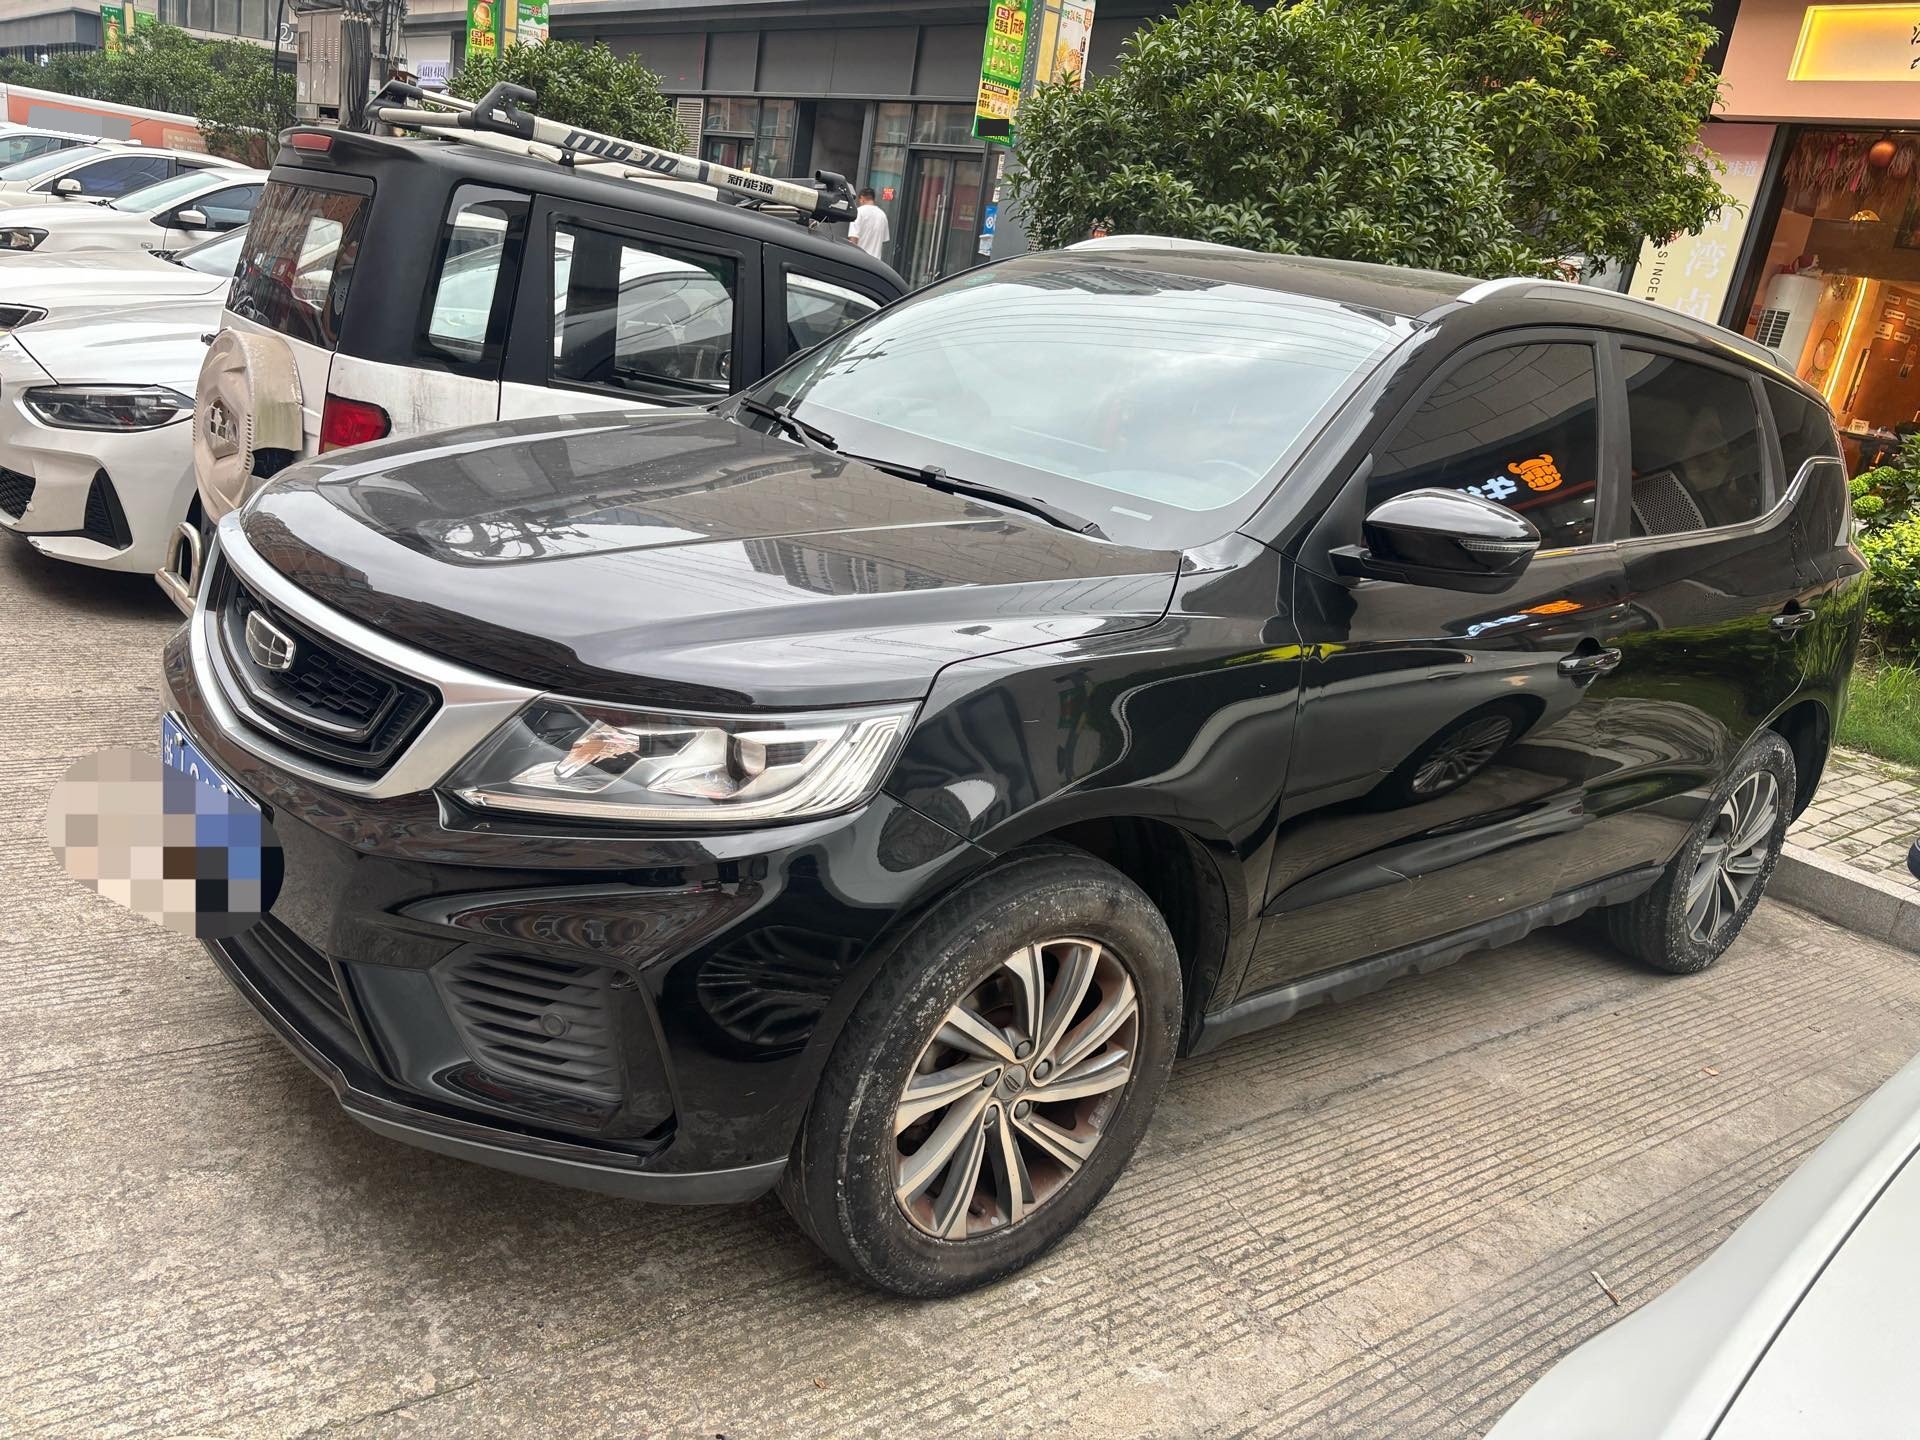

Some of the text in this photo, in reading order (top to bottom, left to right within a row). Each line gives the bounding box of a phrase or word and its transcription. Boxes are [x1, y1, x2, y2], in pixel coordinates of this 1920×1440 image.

[727, 173, 775, 195] 新能源
[1647, 250, 1669, 294] SINCE
